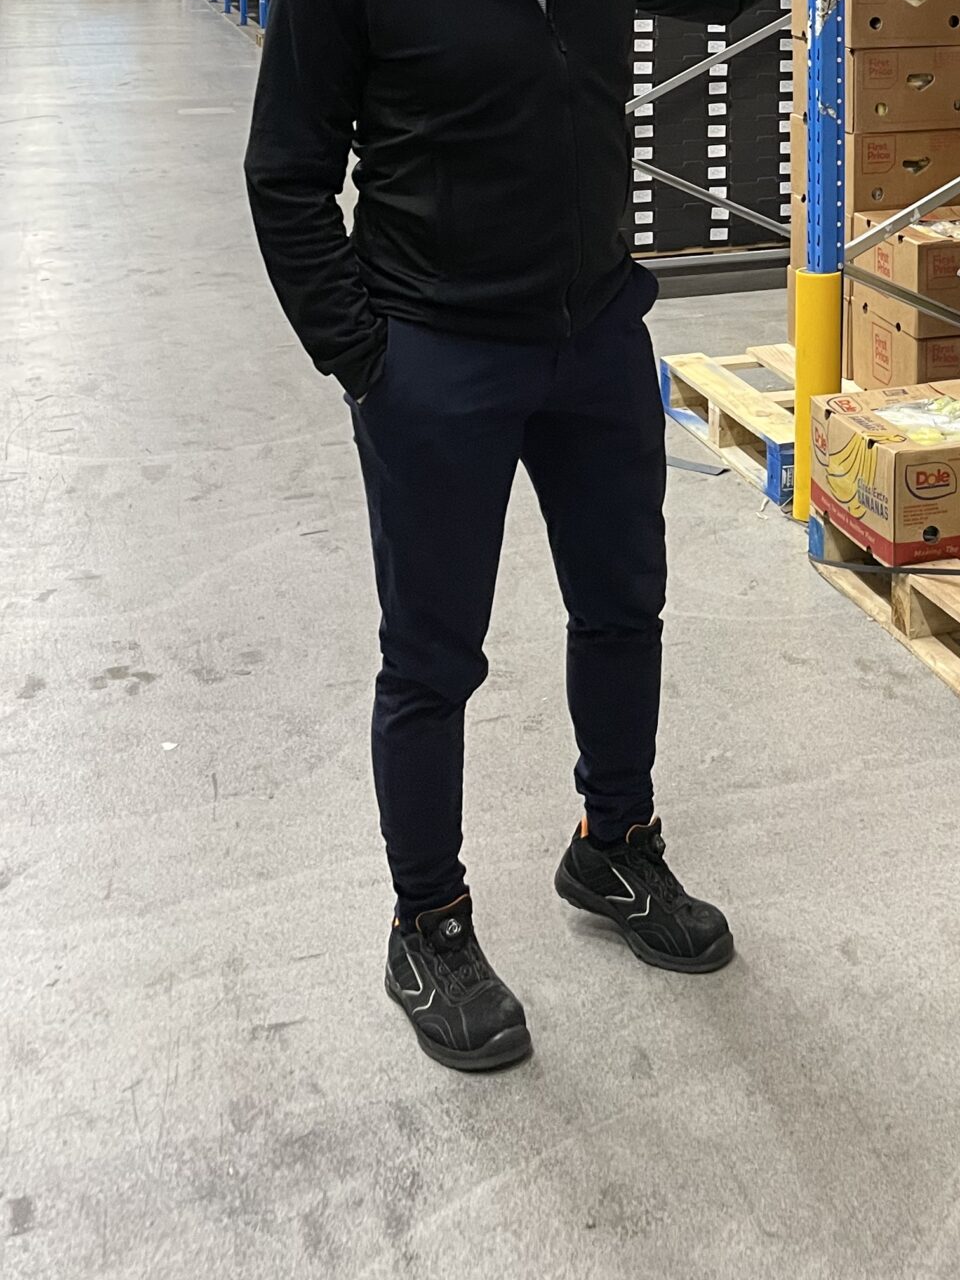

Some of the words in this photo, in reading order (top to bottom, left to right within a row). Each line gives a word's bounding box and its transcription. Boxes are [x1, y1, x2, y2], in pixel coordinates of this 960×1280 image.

[867, 143, 887, 151] First
[867, 150, 890, 160] Price
[875, 334, 887, 351] First
[875, 348, 889, 365] Price
[915, 469, 950, 486] Dole
